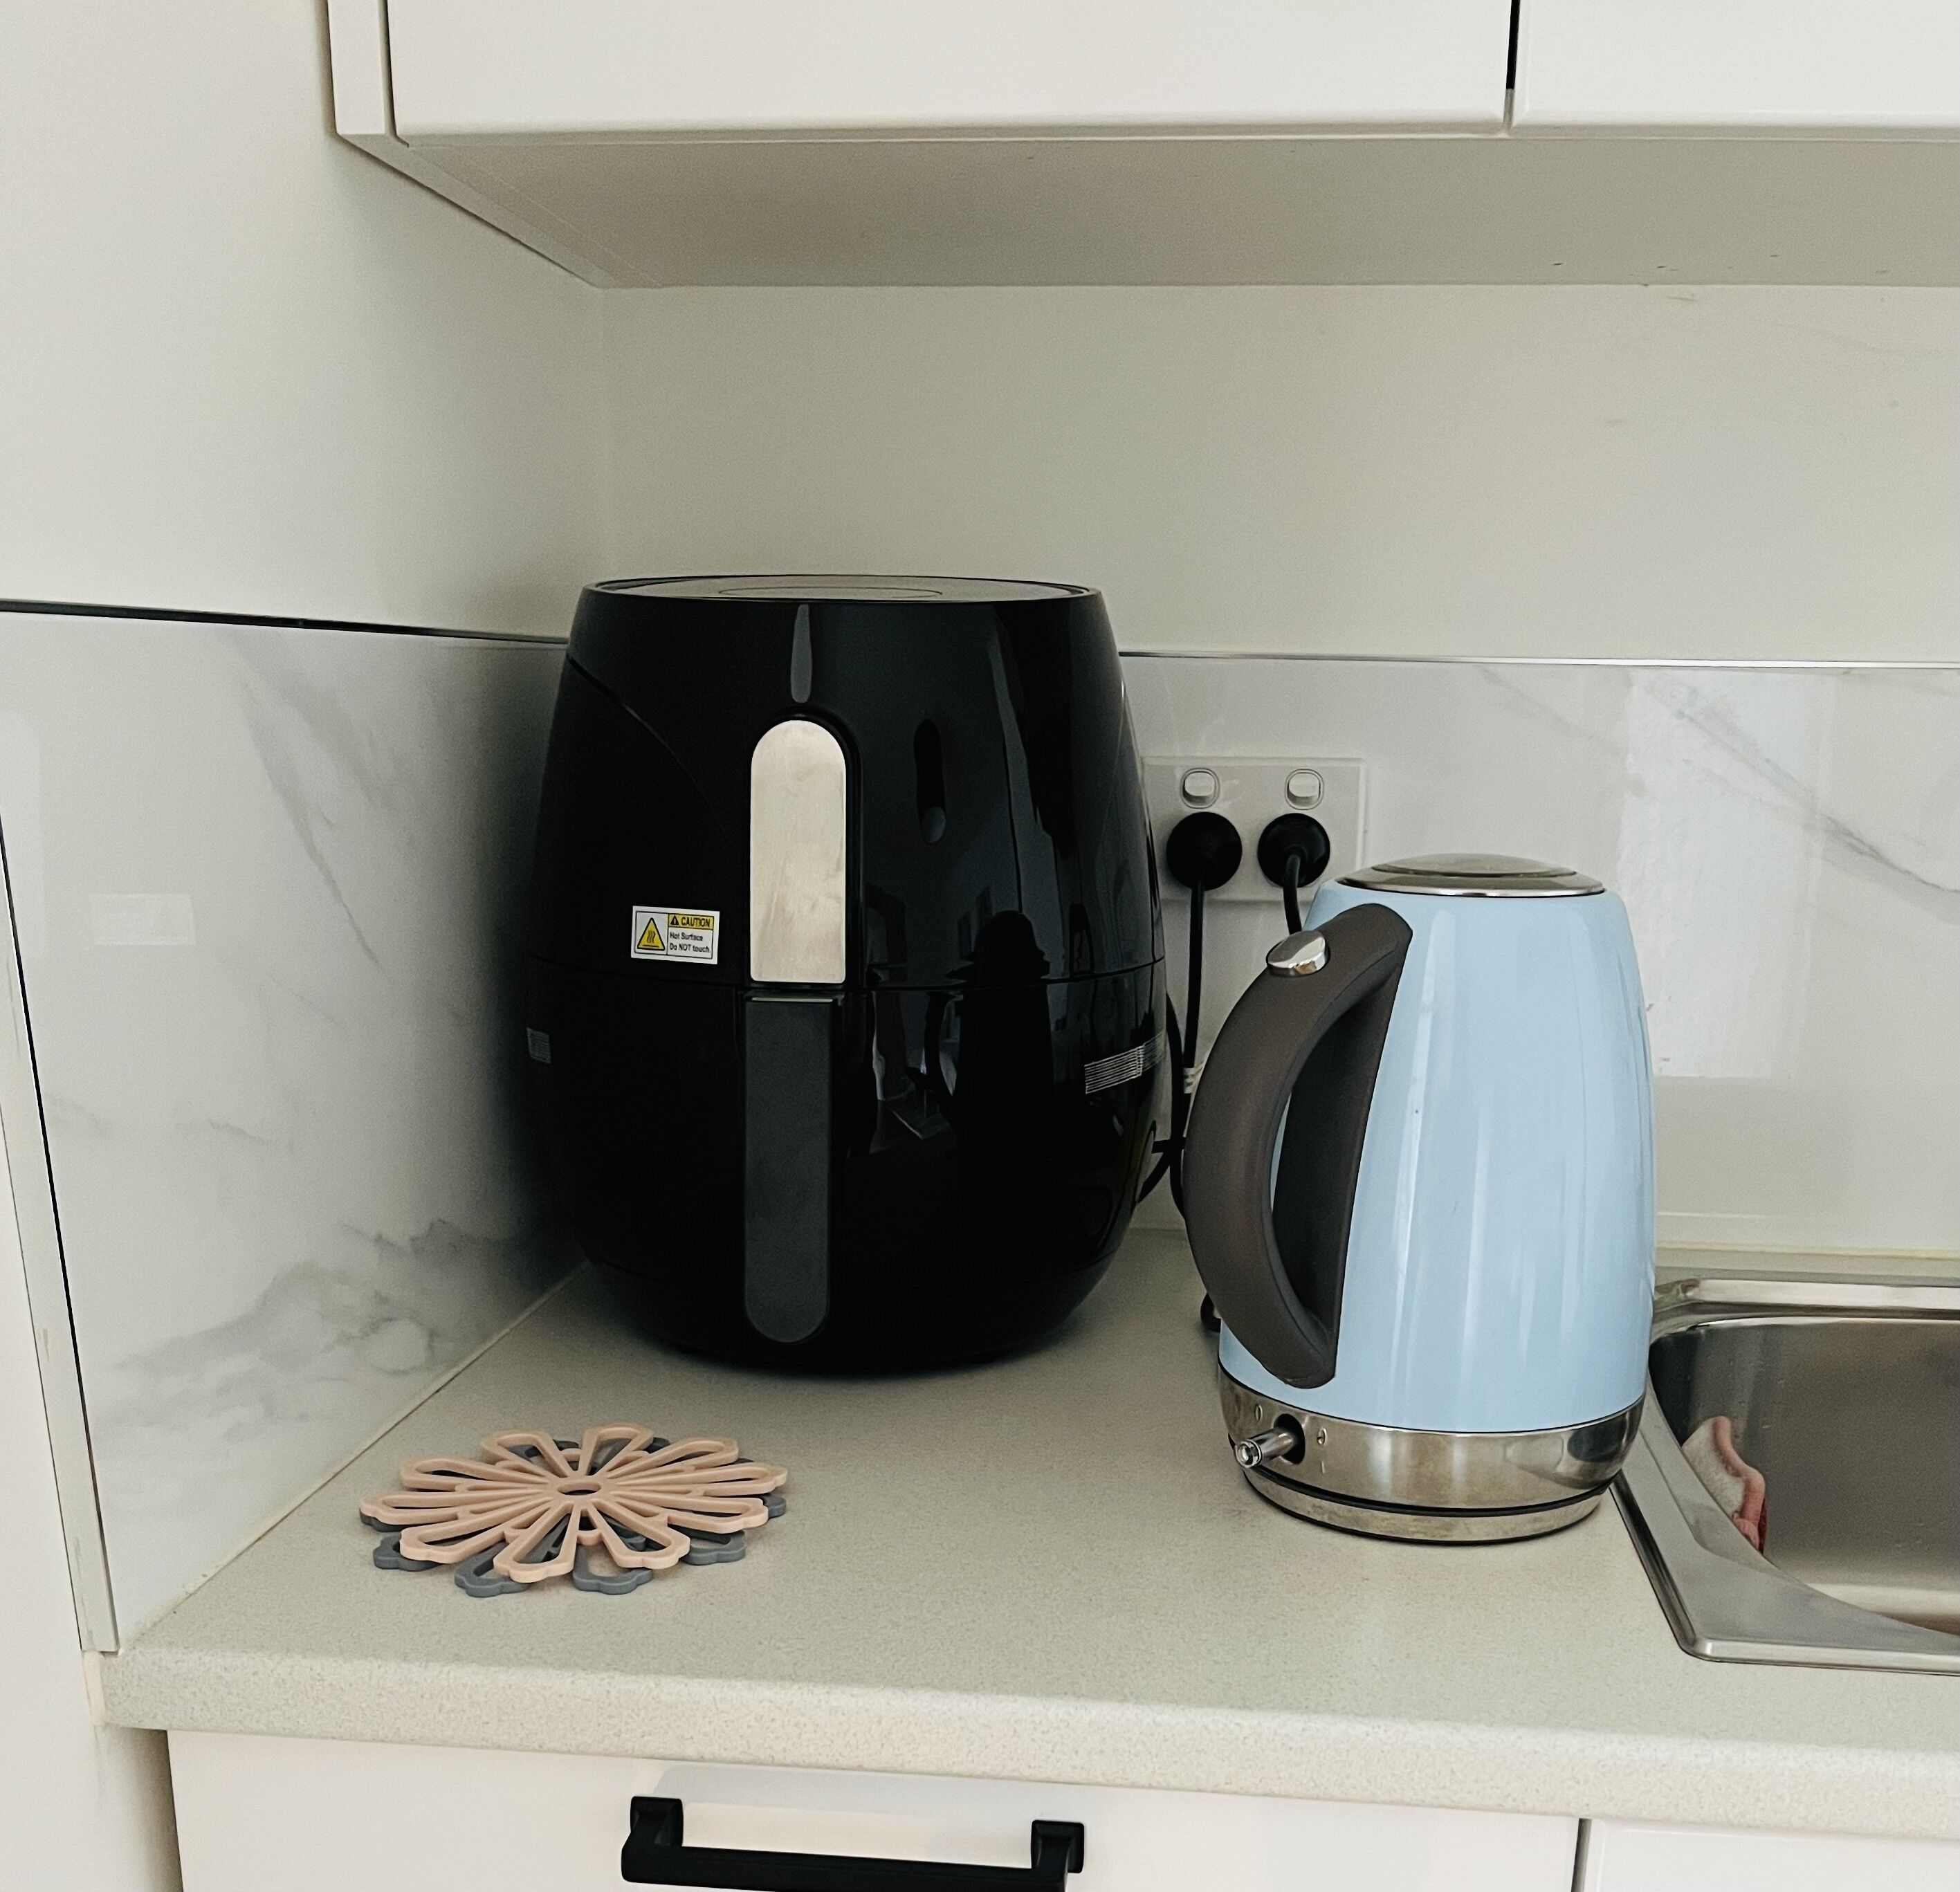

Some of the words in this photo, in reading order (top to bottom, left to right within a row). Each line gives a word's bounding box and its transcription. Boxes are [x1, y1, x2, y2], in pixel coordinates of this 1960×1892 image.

[681, 917, 711, 927] CAUTION
[670, 931, 680, 939] Hot
[681, 932, 703, 941] Surface
[669, 942, 677, 950] Do
